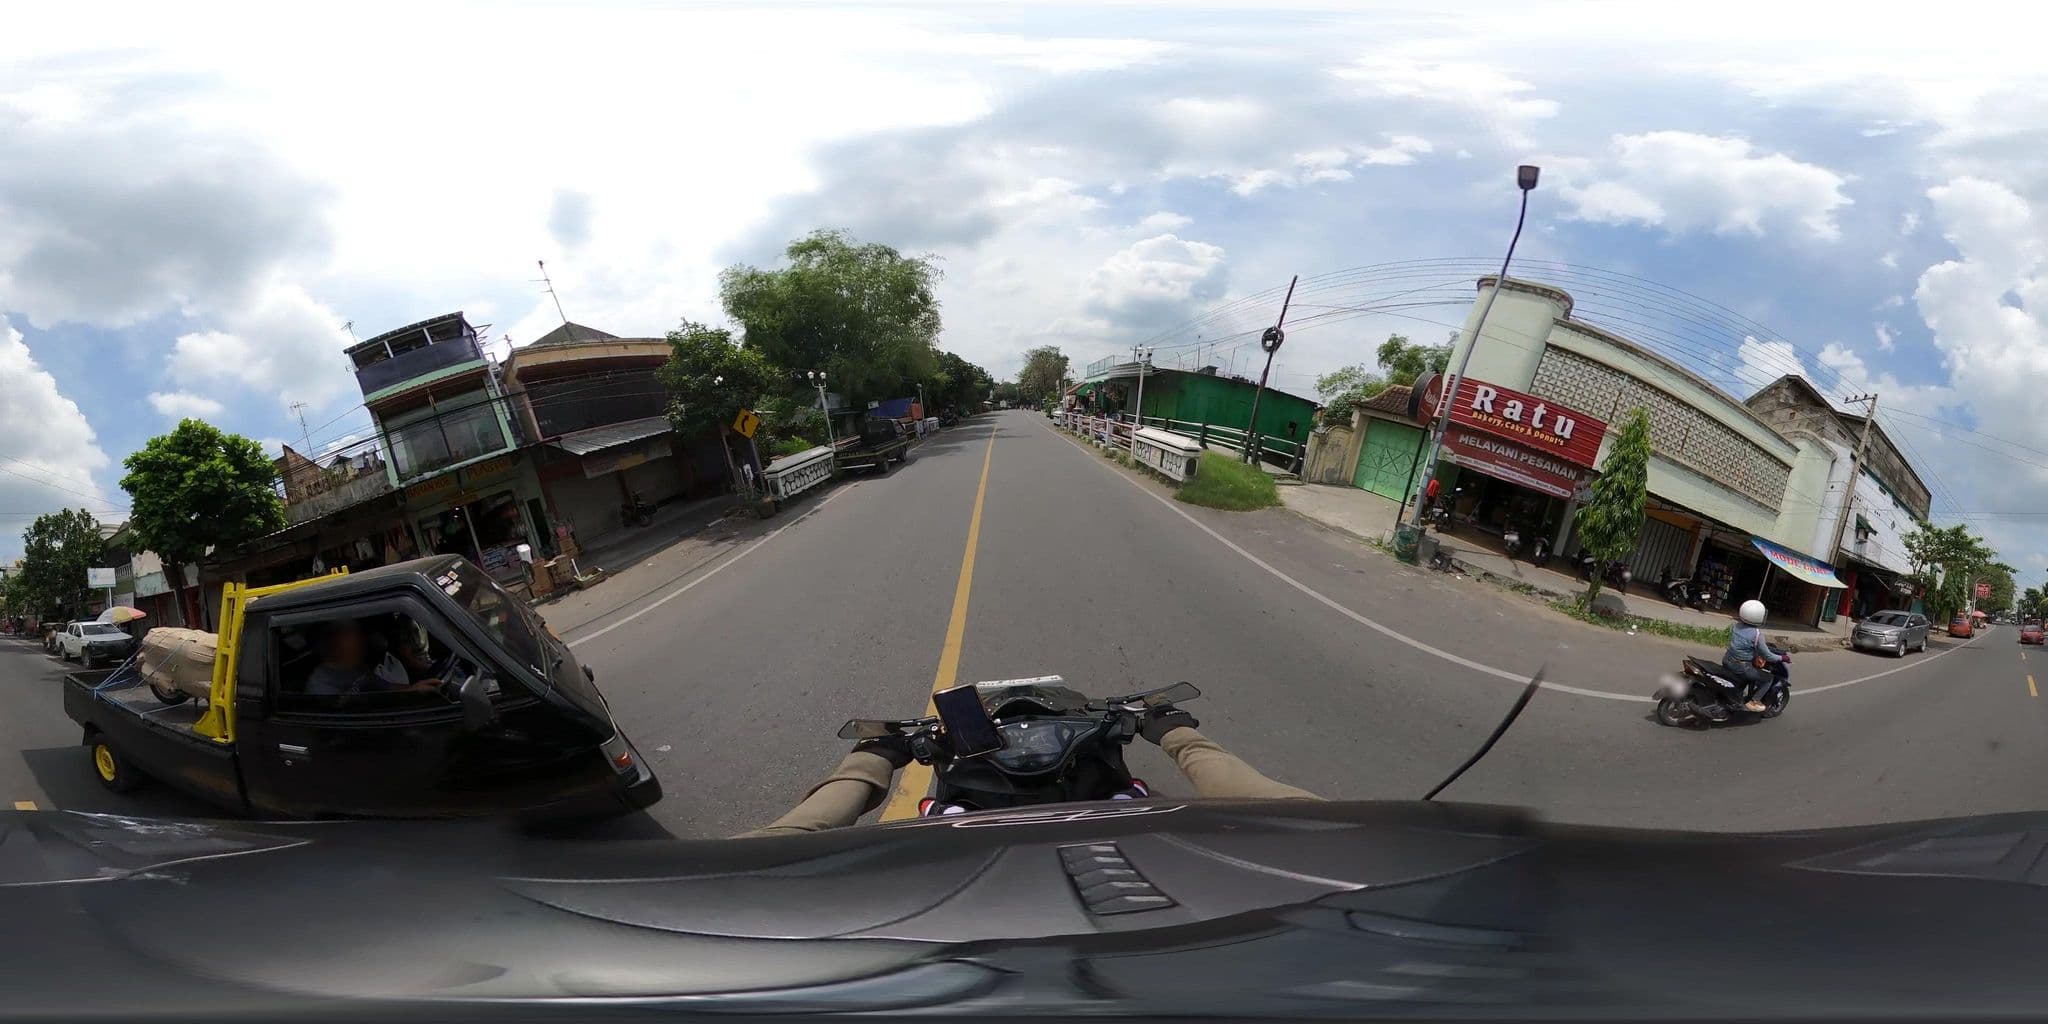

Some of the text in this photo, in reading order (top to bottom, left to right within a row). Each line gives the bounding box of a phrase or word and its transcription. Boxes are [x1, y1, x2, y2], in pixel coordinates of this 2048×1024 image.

[1471, 384, 1576, 440] Ratu
[1504, 421, 1525, 434] Cake
[1459, 435, 1518, 461] MELAYANI
[1520, 453, 1577, 480] PESANAN
